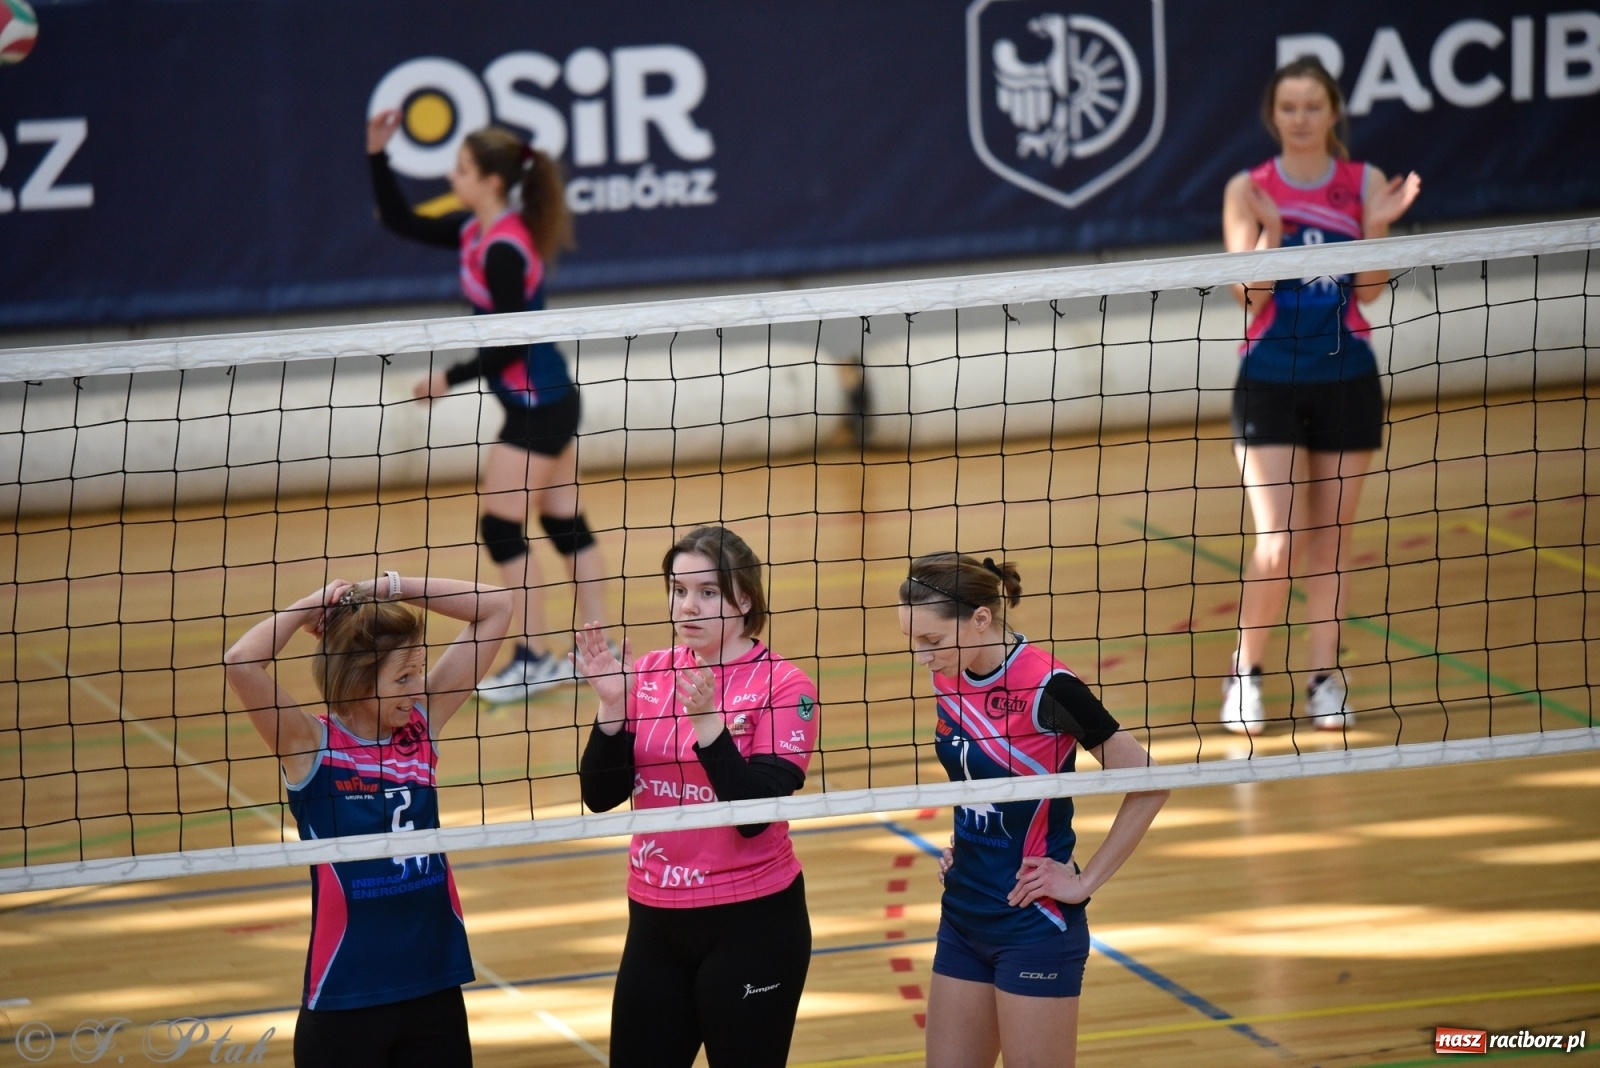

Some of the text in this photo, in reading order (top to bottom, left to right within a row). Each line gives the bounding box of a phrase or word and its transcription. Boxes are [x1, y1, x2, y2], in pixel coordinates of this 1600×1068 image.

[367, 44, 715, 180] OSiR
[0, 117, 95, 213] Z
[636, 690, 660, 704] URON
[384, 785, 415, 833] 2
[649, 779, 719, 802] TAURO
